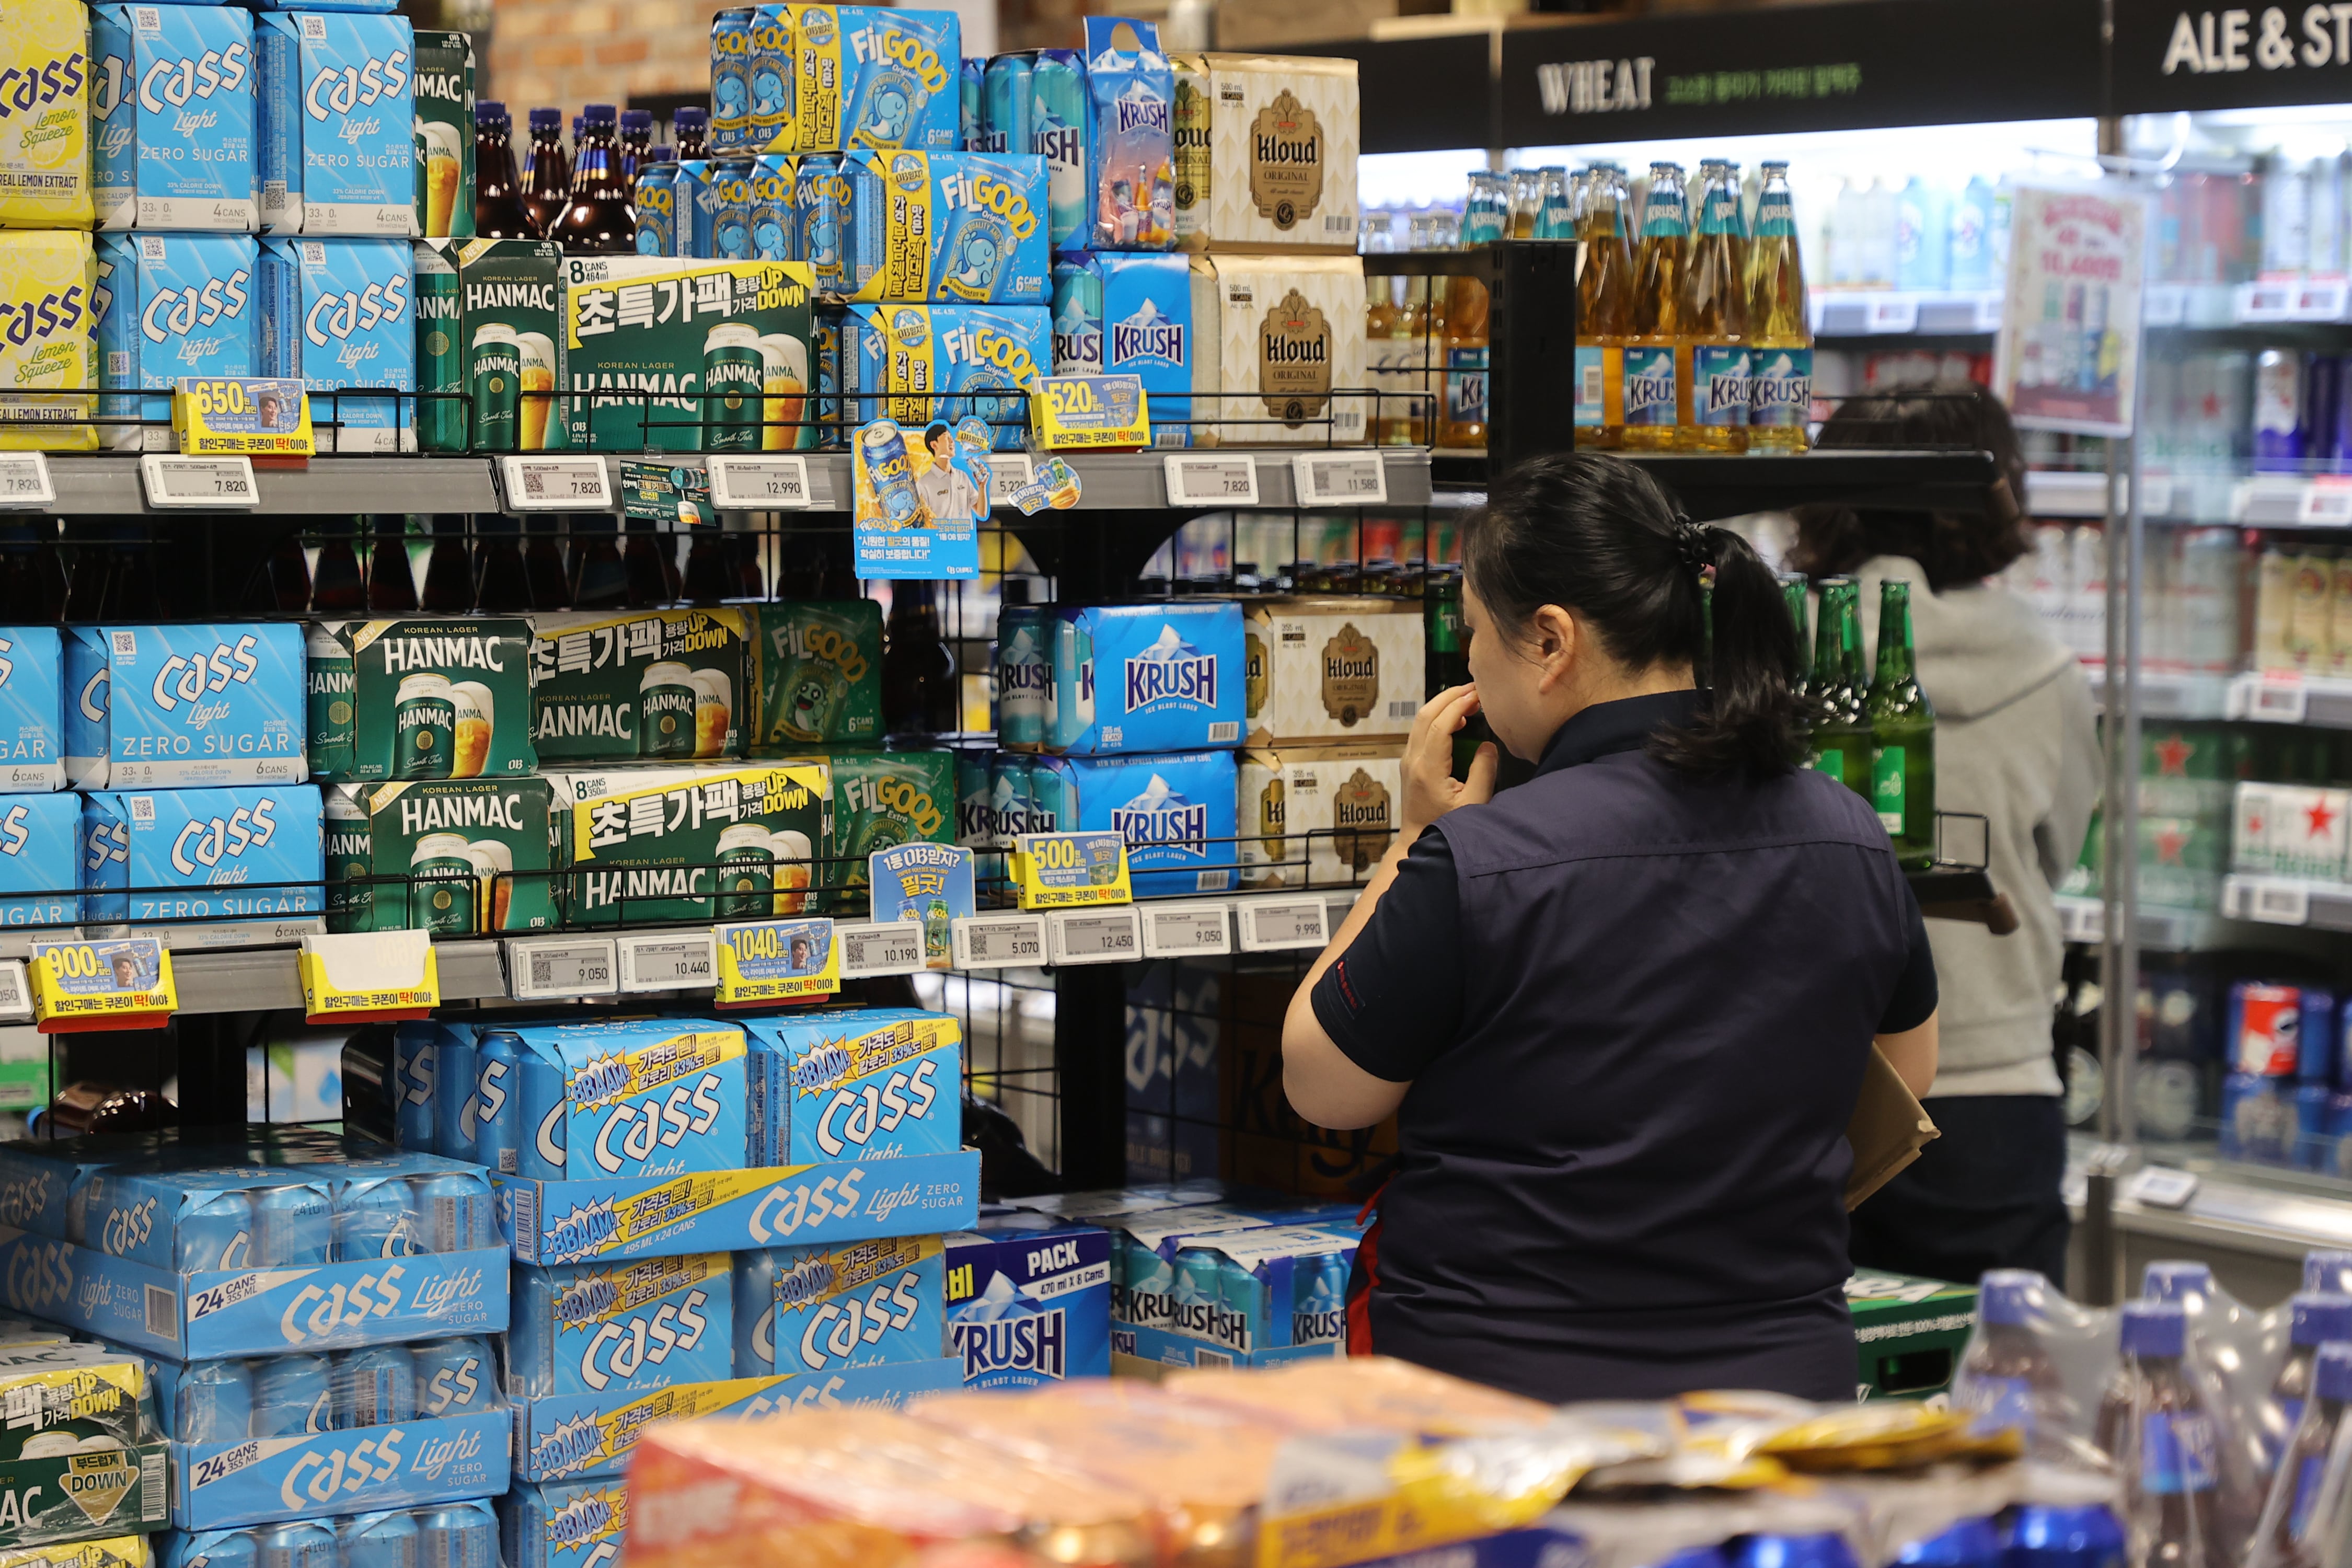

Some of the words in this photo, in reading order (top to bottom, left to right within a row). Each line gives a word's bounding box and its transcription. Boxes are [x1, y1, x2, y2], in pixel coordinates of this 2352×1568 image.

[2162, 8, 2250, 75] ALE
[2256, 5, 2295, 70] &
[821, 58, 835, 88] 맛은
[892, 64, 918, 80] Original
[1537, 56, 1655, 115] WHEAT
[34, 109, 78, 130] Lemon
[172, 109, 217, 138] Light
[819, 89, 836, 144] 제대로
[1118, 99, 1169, 136] KRUSH
[20, 125, 74, 150] Squeeze
[338, 116, 381, 145] Light
[141, 147, 185, 160] ZERO
[192, 149, 248, 163] SUGAR
[307, 154, 349, 167] ZERO
[356, 156, 409, 169] SUGAR
[1257, 133, 1319, 167] Kloud
[18, 175, 43, 187] LEMON
[45, 176, 78, 189] EXTRACT
[1264, 170, 1310, 181] ORIGINAL
[376, 209, 385, 223] 4
[385, 213, 408, 222] CANS
[894, 195, 906, 225] 가격
[910, 204, 925, 236] 맛은
[981, 209, 1008, 226] Original
[464, 242, 483, 261] NEW
[907, 236, 927, 292] 제대로
[585, 271, 609, 282] 464ml
[467, 283, 555, 312] HANMAC
[576, 271, 732, 338] 초특가팩
[30, 341, 76, 365] Lemon
[1112, 322, 1184, 369] KRUSH
[1265, 332, 1328, 366] Kloud
[14, 358, 73, 384] Squeeze
[984, 363, 1011, 379] Original
[1273, 370, 1318, 379] ORIGINAL
[195, 381, 245, 415] 650
[573, 373, 697, 413] HANMAC
[1048, 381, 1092, 414] 520
[1752, 374, 1811, 414] KRUSH
[860, 549, 884, 560] 확실히
[886, 536, 909, 547] 필굿의
[911, 535, 930, 547] 품질!
[356, 625, 377, 643] NEW
[384, 636, 504, 676] HANMAC
[1327, 655, 1376, 680] Kloud
[1125, 654, 1217, 714] KRUSH
[185, 700, 231, 731] Light
[398, 707, 453, 734] HANMAC
[123, 735, 191, 756] ZERO
[203, 733, 289, 753] SUGAR
[256, 761, 264, 775] 6
[265, 765, 287, 775] CANS
[374, 783, 395, 806] NEW
[464, 785, 498, 793] LAGER
[575, 781, 586, 800] 8
[586, 778, 606, 788] CANS
[587, 786, 607, 797] 350ml
[401, 793, 523, 836] HANMAC
[590, 780, 739, 850] 초특가팩
[887, 810, 908, 824] Extra
[1339, 801, 1388, 825] Kloud
[1111, 803, 1207, 859] KRUSH
[883, 855, 903, 872] 1등
[1034, 839, 1075, 870] 500
[585, 868, 706, 910] HANMAC
[901, 873, 945, 898] 필굿!
[45, 945, 98, 979] 900
[98, 967, 111, 976] 할인
[734, 984, 776, 997] 할인구매는
[777, 981, 803, 994] 쿠폰이
[858, 1031, 895, 1058] 가격도
[895, 1020, 914, 1044] 뺌!
[794, 1048, 852, 1088] BBAAM!
[857, 1051, 889, 1077] 칼로리
[891, 1041, 921, 1063] 33%도
[922, 1032, 937, 1052] 뺌!
[637, 1068, 671, 1091] 칼로리
[672, 1054, 705, 1078] 33%도
[705, 1046, 721, 1066] 뺌!
[571, 1064, 631, 1103] BBAAM!
[630, 1191, 672, 1220] 가격도
[672, 1179, 693, 1204] 뺌!
[864, 1182, 920, 1222] Light
[921, 1194, 964, 1210] SUGAR
[926, 1182, 960, 1196] ZERO
[628, 1211, 663, 1238] 칼로리
[662, 1197, 697, 1223] 33%도
[697, 1189, 713, 1210] 뺌!
[551, 1210, 617, 1255] BBAAM!
[1026, 1240, 1080, 1277] PACK
[225, 1274, 257, 1295] CANS
[226, 1290, 244, 1305] 355
[244, 1284, 258, 1296] ML
[410, 1266, 482, 1316] Light
[778, 1260, 836, 1305] BBAAM!
[194, 1292, 224, 1319] 24
[558, 1279, 618, 1323] BBAAM!
[76, 1452, 119, 1468] 부드럽게
[227, 1442, 259, 1462] CANS
[410, 1430, 481, 1478] Light
[71, 1470, 127, 1493] DOWN
[197, 1459, 226, 1486] 24
[447, 1473, 487, 1485] SUGAR
[452, 1463, 483, 1476] ZERO
